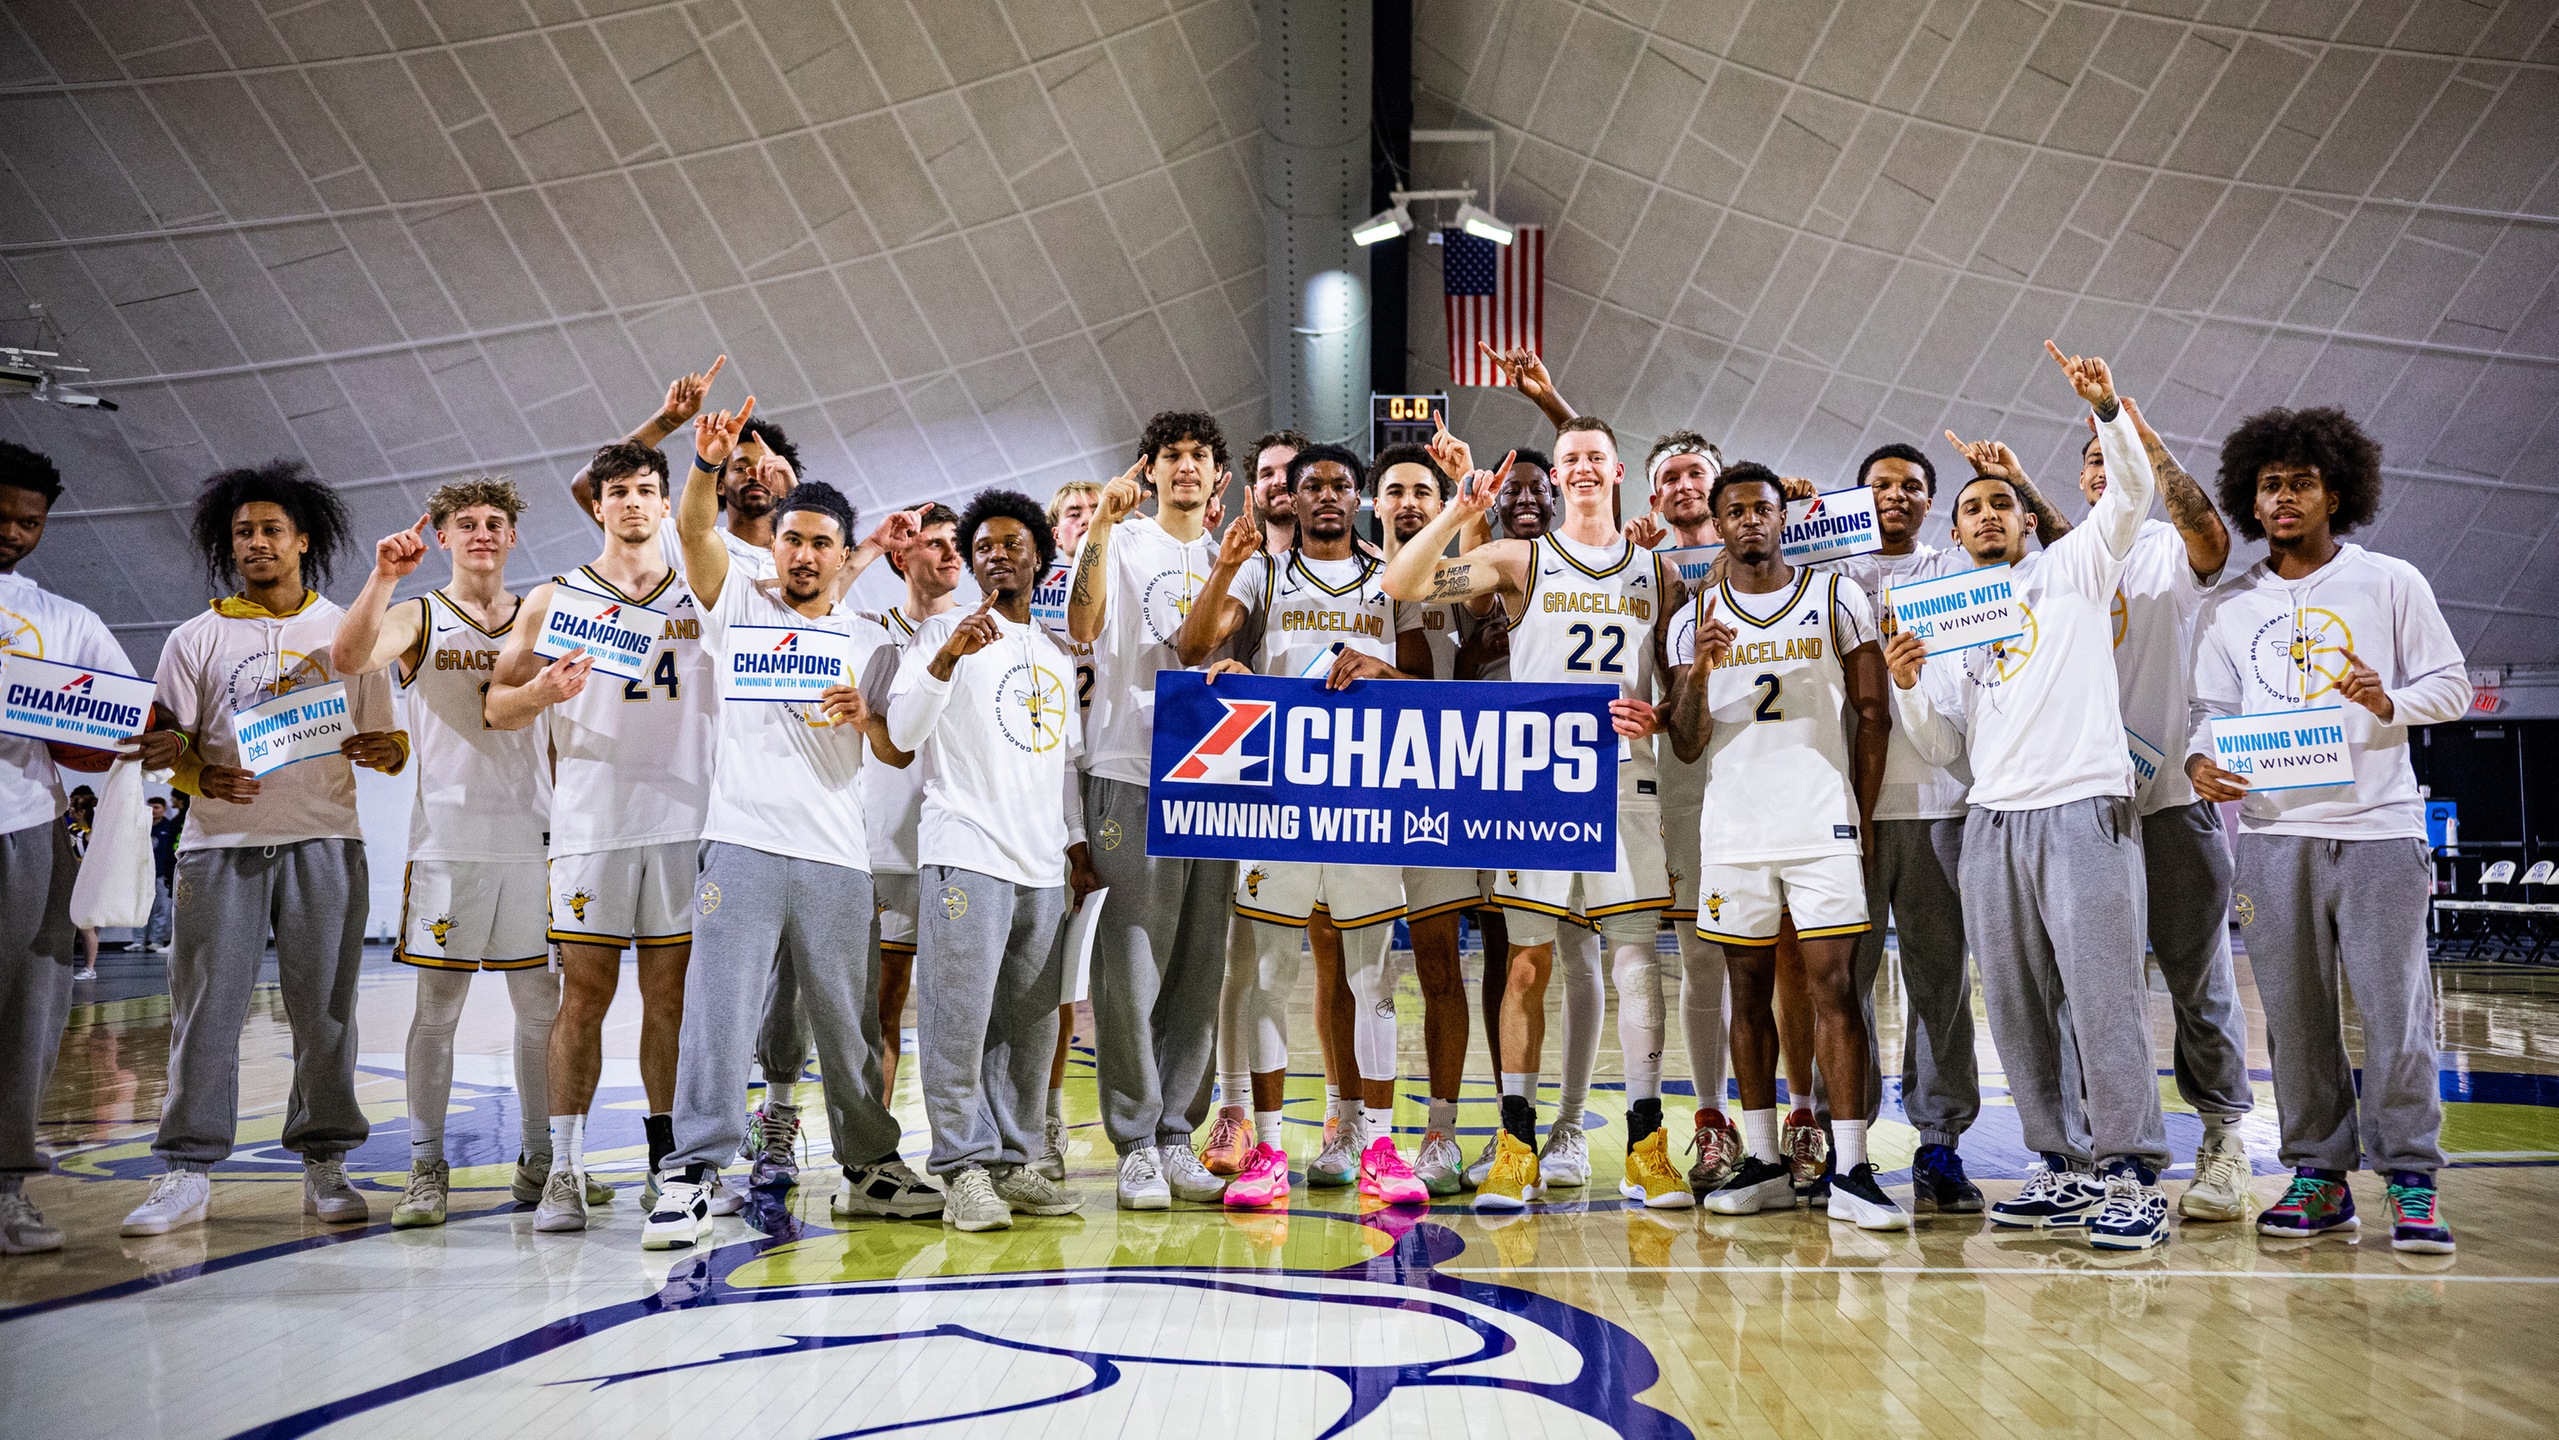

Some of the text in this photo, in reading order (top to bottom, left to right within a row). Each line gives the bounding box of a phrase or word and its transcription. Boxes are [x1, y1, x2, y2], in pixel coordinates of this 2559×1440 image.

[1780, 511, 1872, 544] HAMPIONS
[1782, 532, 1873, 557] INNING WITH WINWON
[1143, 569, 1182, 603] BASKETBALL
[1897, 581, 2012, 622] WINNING WITH
[1045, 610, 1065, 619] WITH
[1543, 592, 1651, 621] GRACELAND
[1939, 607, 2008, 632] WINWON
[550, 611, 652, 655] CHAMPIONS
[1282, 611, 1385, 638] GRACELAND
[2251, 612, 2295, 661] BASKETBAL
[435, 649, 500, 671] GRACE
[587, 646, 608, 660] WITH
[608, 652, 642, 667] WINWON
[1565, 621, 1627, 675] 22
[733, 653, 841, 677] CHAMPIONS
[735, 677, 772, 688] WINNING
[774, 678, 797, 688] WITH
[995, 662, 1030, 703] BASKETBALL
[1754, 671, 1785, 724] 2
[7, 684, 141, 728] CHAMPIONS
[2474, 693, 2498, 711] EXIT
[6, 708, 133, 740] WINNING WITH WINWON
[238, 697, 346, 745] WINNING WITH
[273, 722, 342, 748] WINWON
[995, 707, 1032, 753] GRACELAND
[1285, 706, 1599, 794] CHAMPS
[2217, 726, 2344, 754] WINNING WITH
[2259, 752, 2338, 770] WINWON
[1161, 800, 1602, 843] WINNING WITH WINWON
